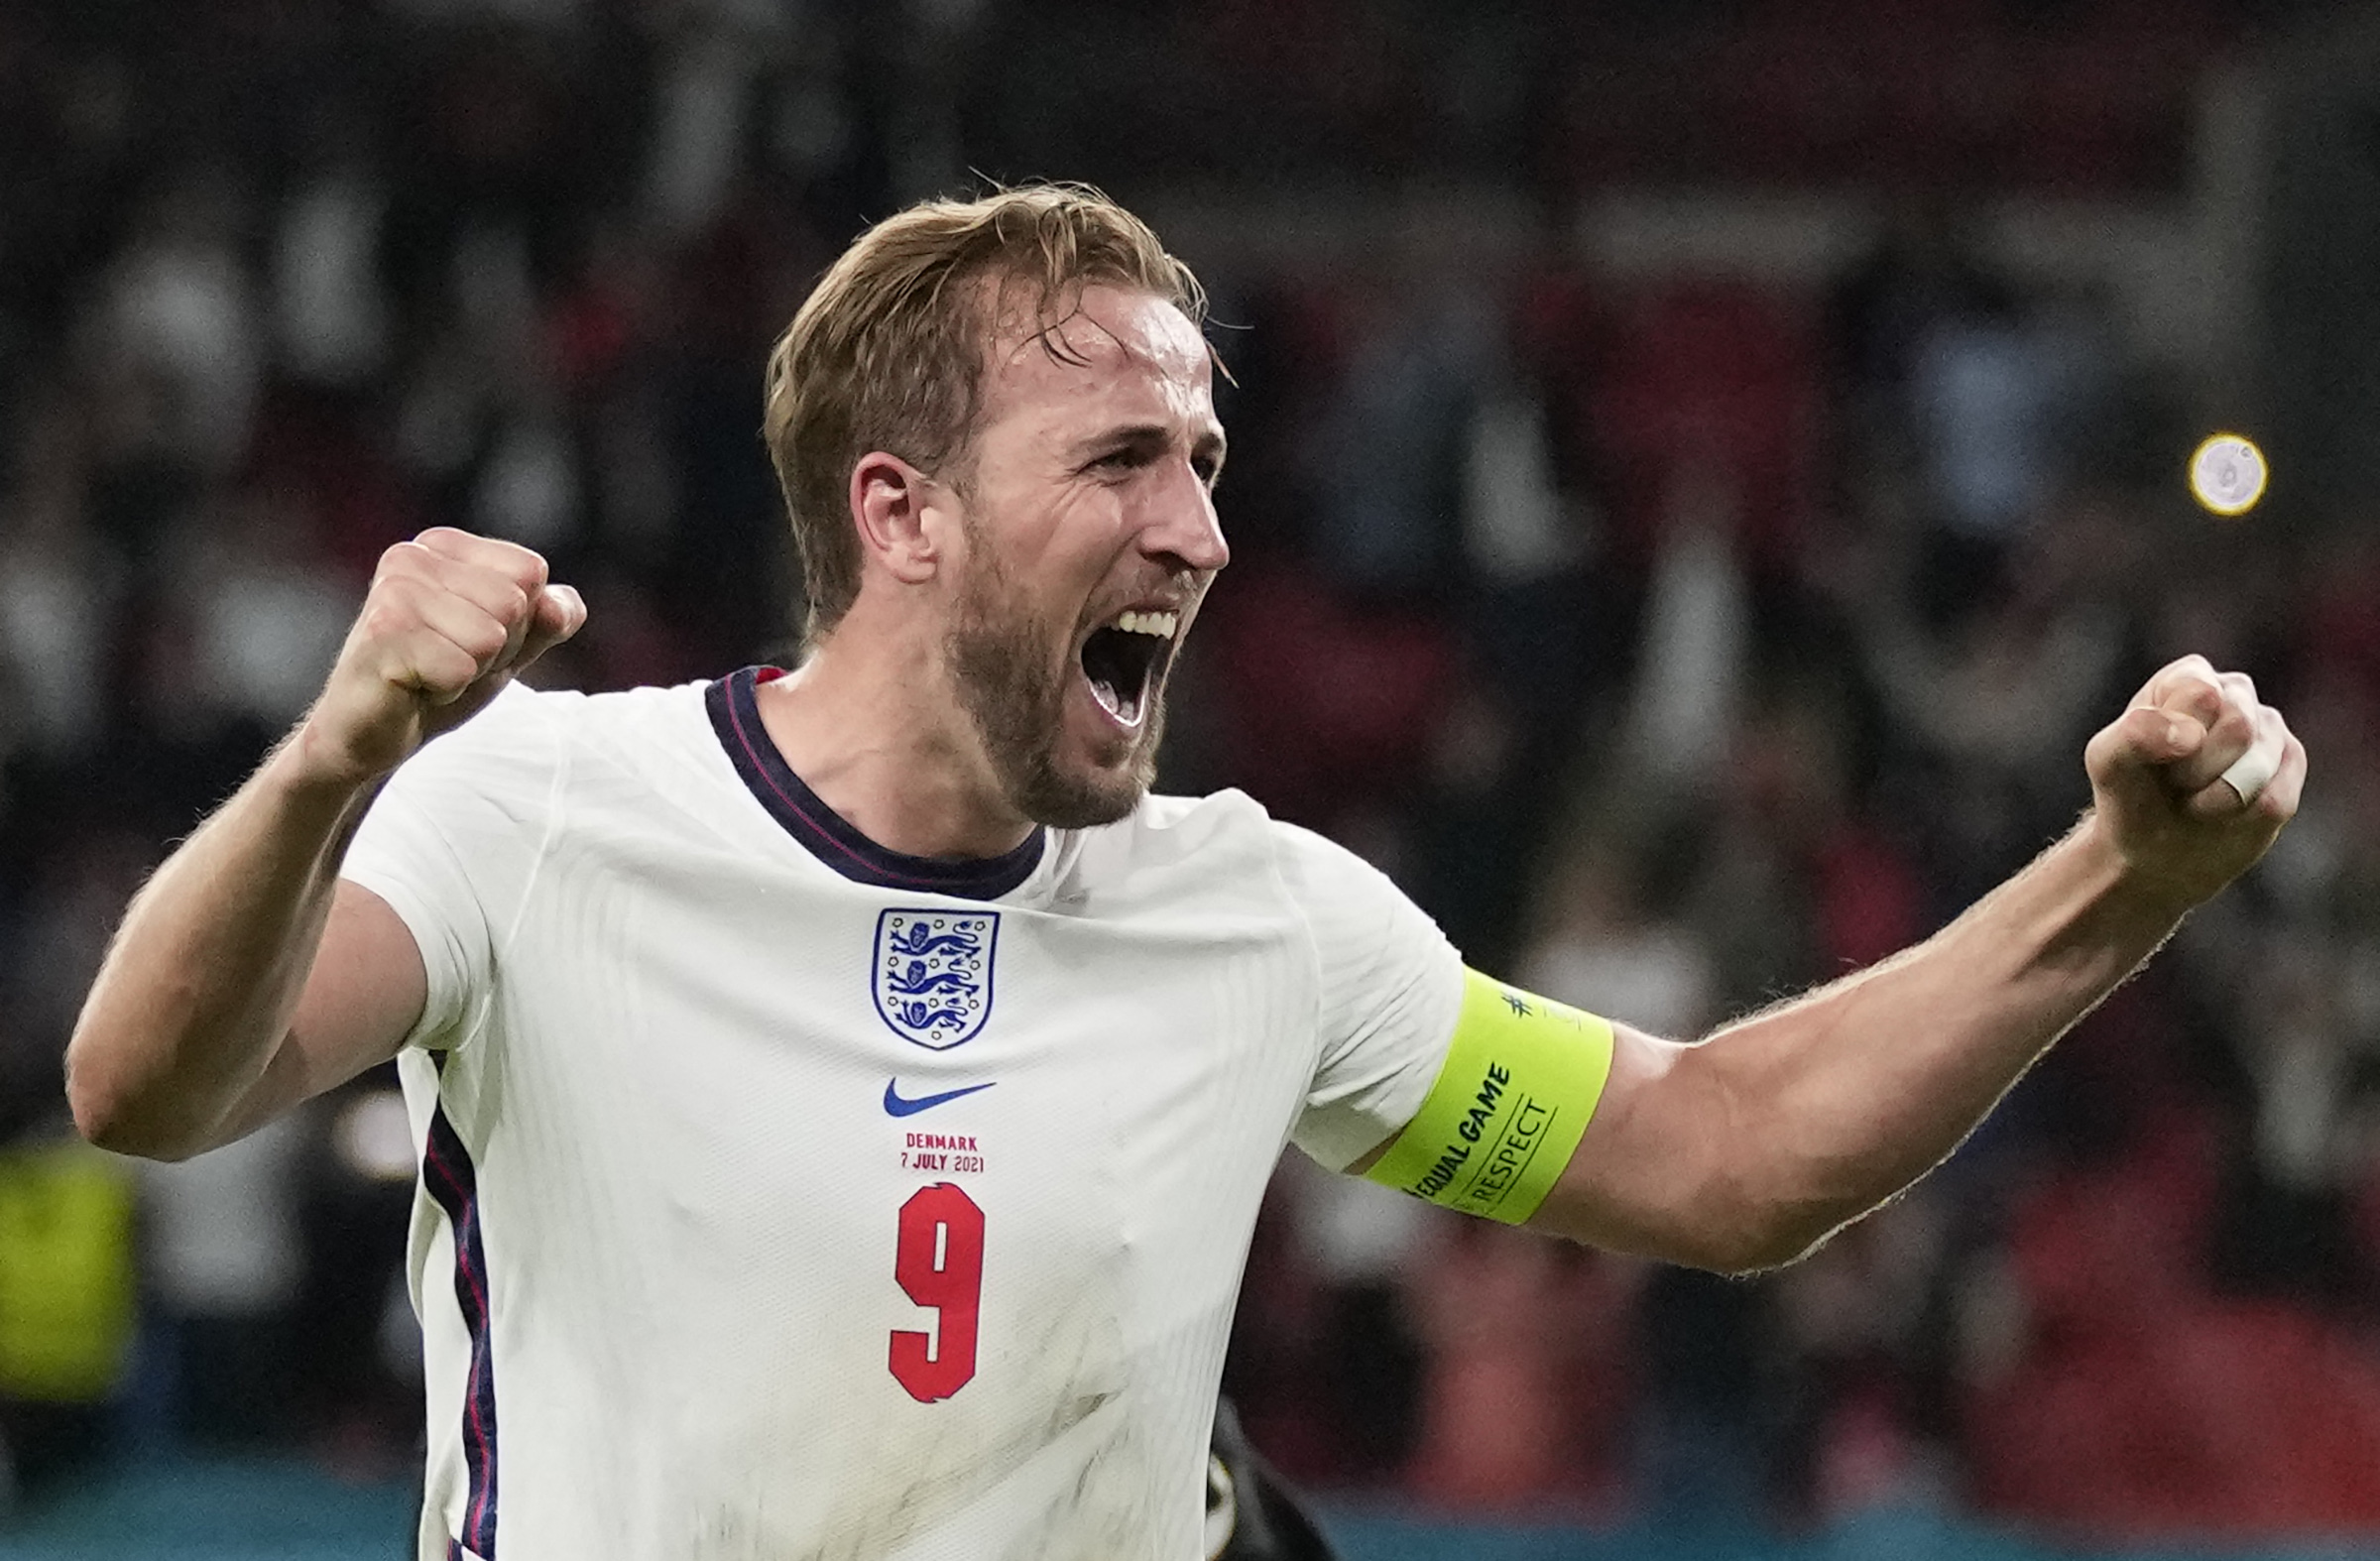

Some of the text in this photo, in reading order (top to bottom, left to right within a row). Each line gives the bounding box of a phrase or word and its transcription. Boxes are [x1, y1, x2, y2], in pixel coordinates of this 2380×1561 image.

[900, 1151, 984, 1173] 7 JULY 2021
[905, 1133, 978, 1152] DENMARK
[1472, 1097, 1547, 1202] RESPECT
[889, 1181, 985, 1403] 9
